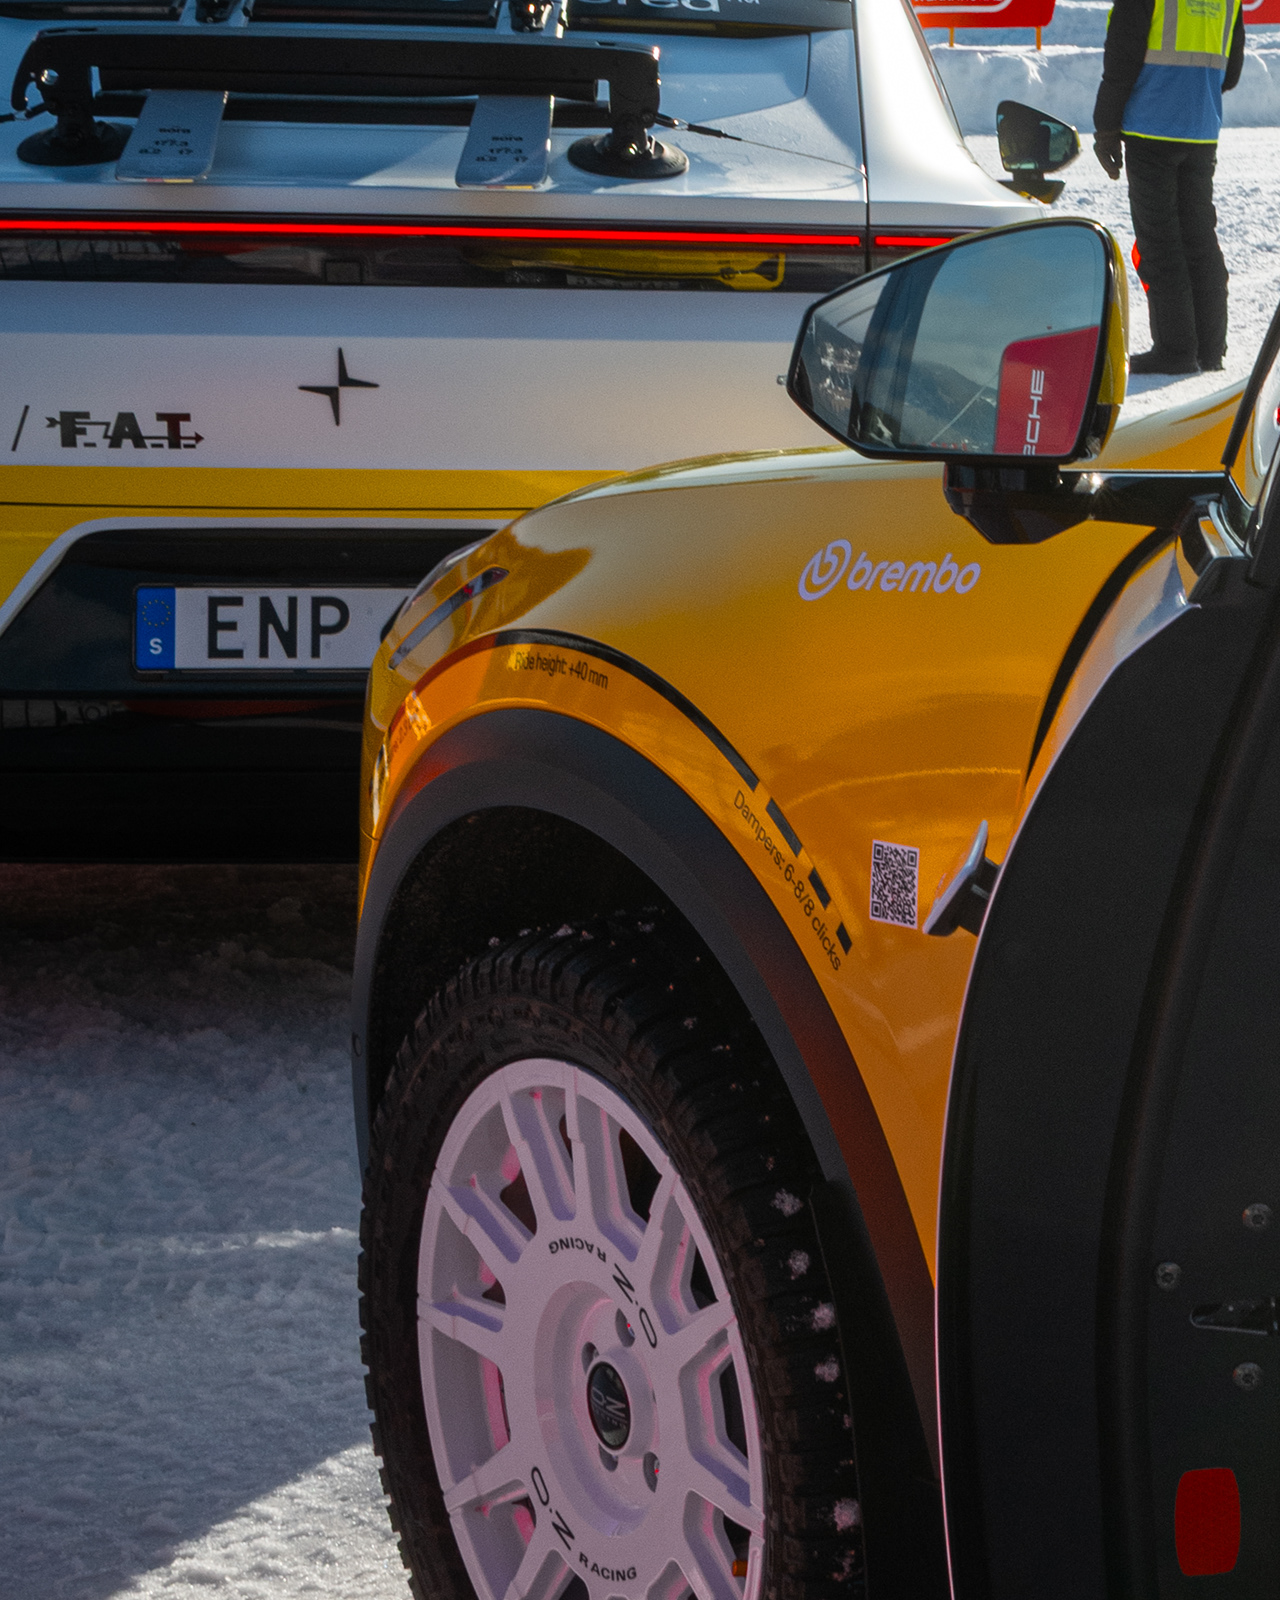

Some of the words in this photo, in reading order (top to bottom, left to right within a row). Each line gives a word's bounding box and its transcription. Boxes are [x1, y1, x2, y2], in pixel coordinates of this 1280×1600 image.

[847, 551, 982, 595] brembo
[207, 596, 350, 659] ENP
[150, 638, 163, 655] S
[568, 660, 589, 681] +40
[588, 669, 609, 690] mm
[733, 790, 785, 870] Dampers:
[784, 863, 815, 917] 6-8/8
[811, 916, 841, 971] clicks
[548, 1236, 606, 1263] RACING
[578, 1551, 637, 1581] RACING
